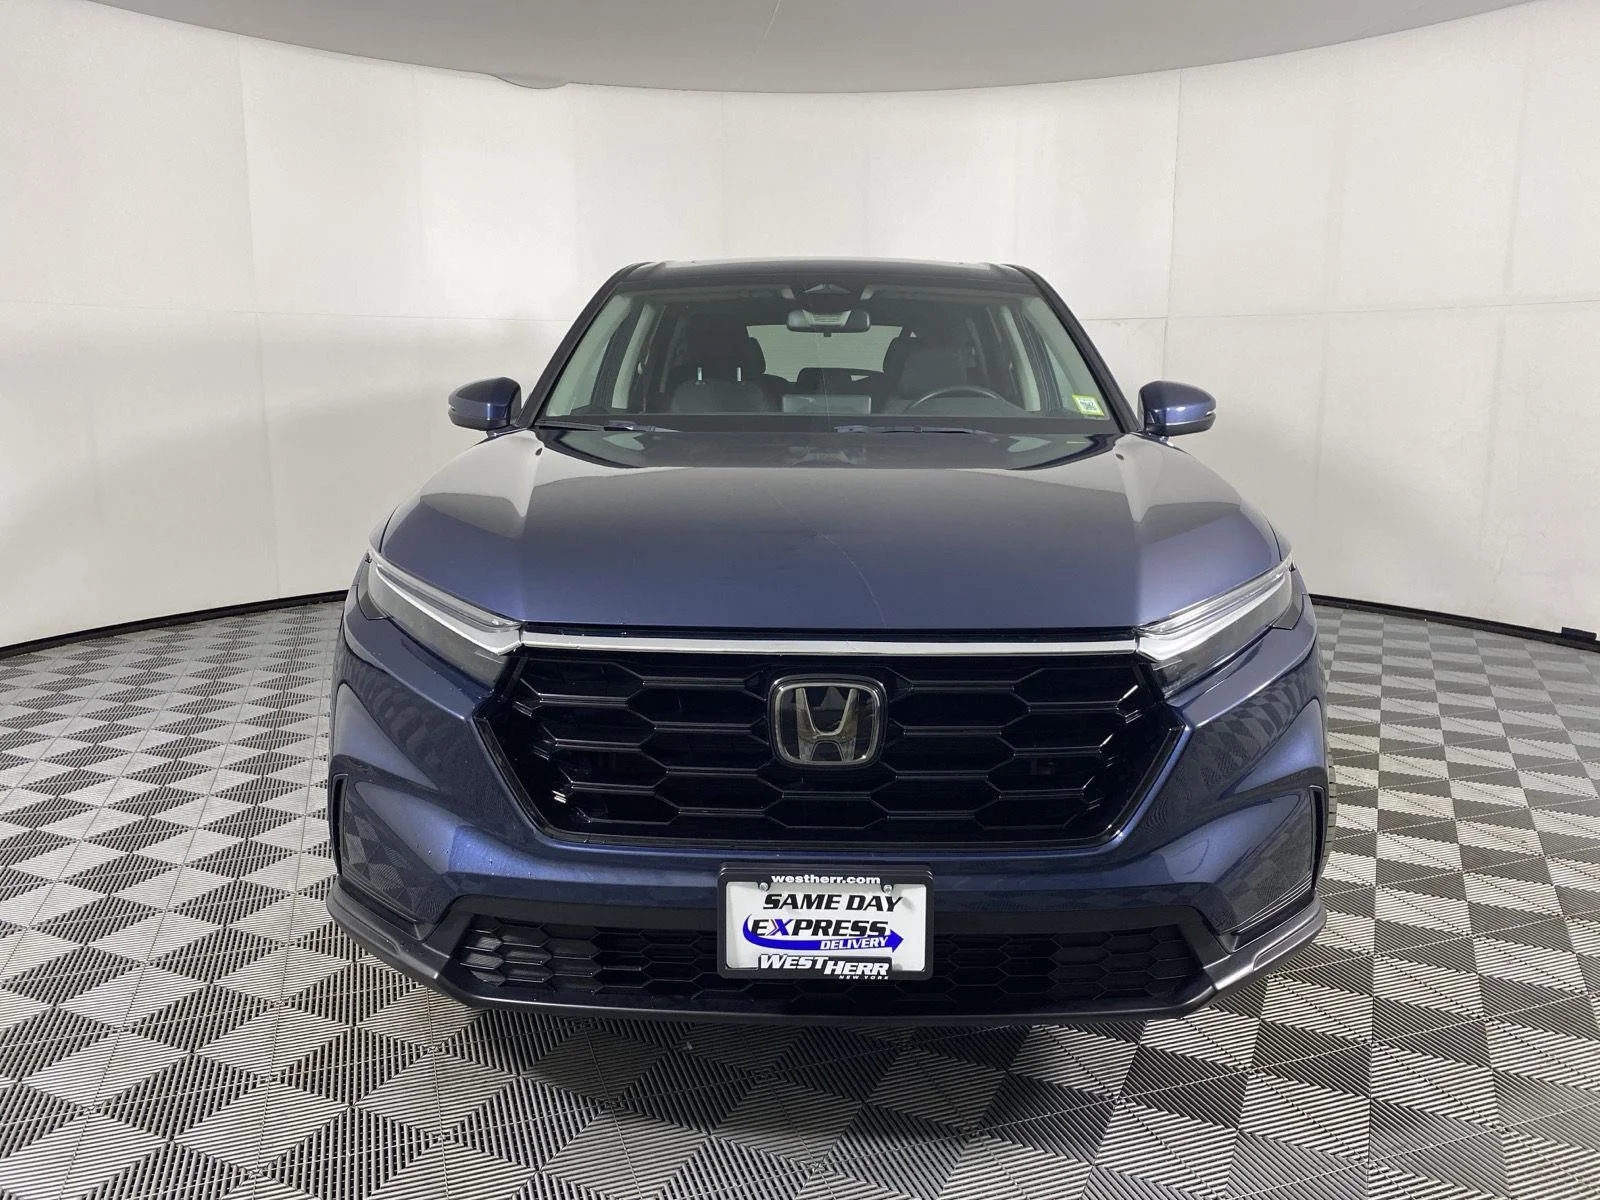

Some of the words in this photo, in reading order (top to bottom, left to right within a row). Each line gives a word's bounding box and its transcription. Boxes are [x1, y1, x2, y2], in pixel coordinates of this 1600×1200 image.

[771, 874, 880, 884] westherr.com
[763, 893, 842, 910] SAME
[846, 894, 903, 912] DAY
[751, 919, 888, 936] EXPRESS
[820, 936, 888, 950] DELIVERY
